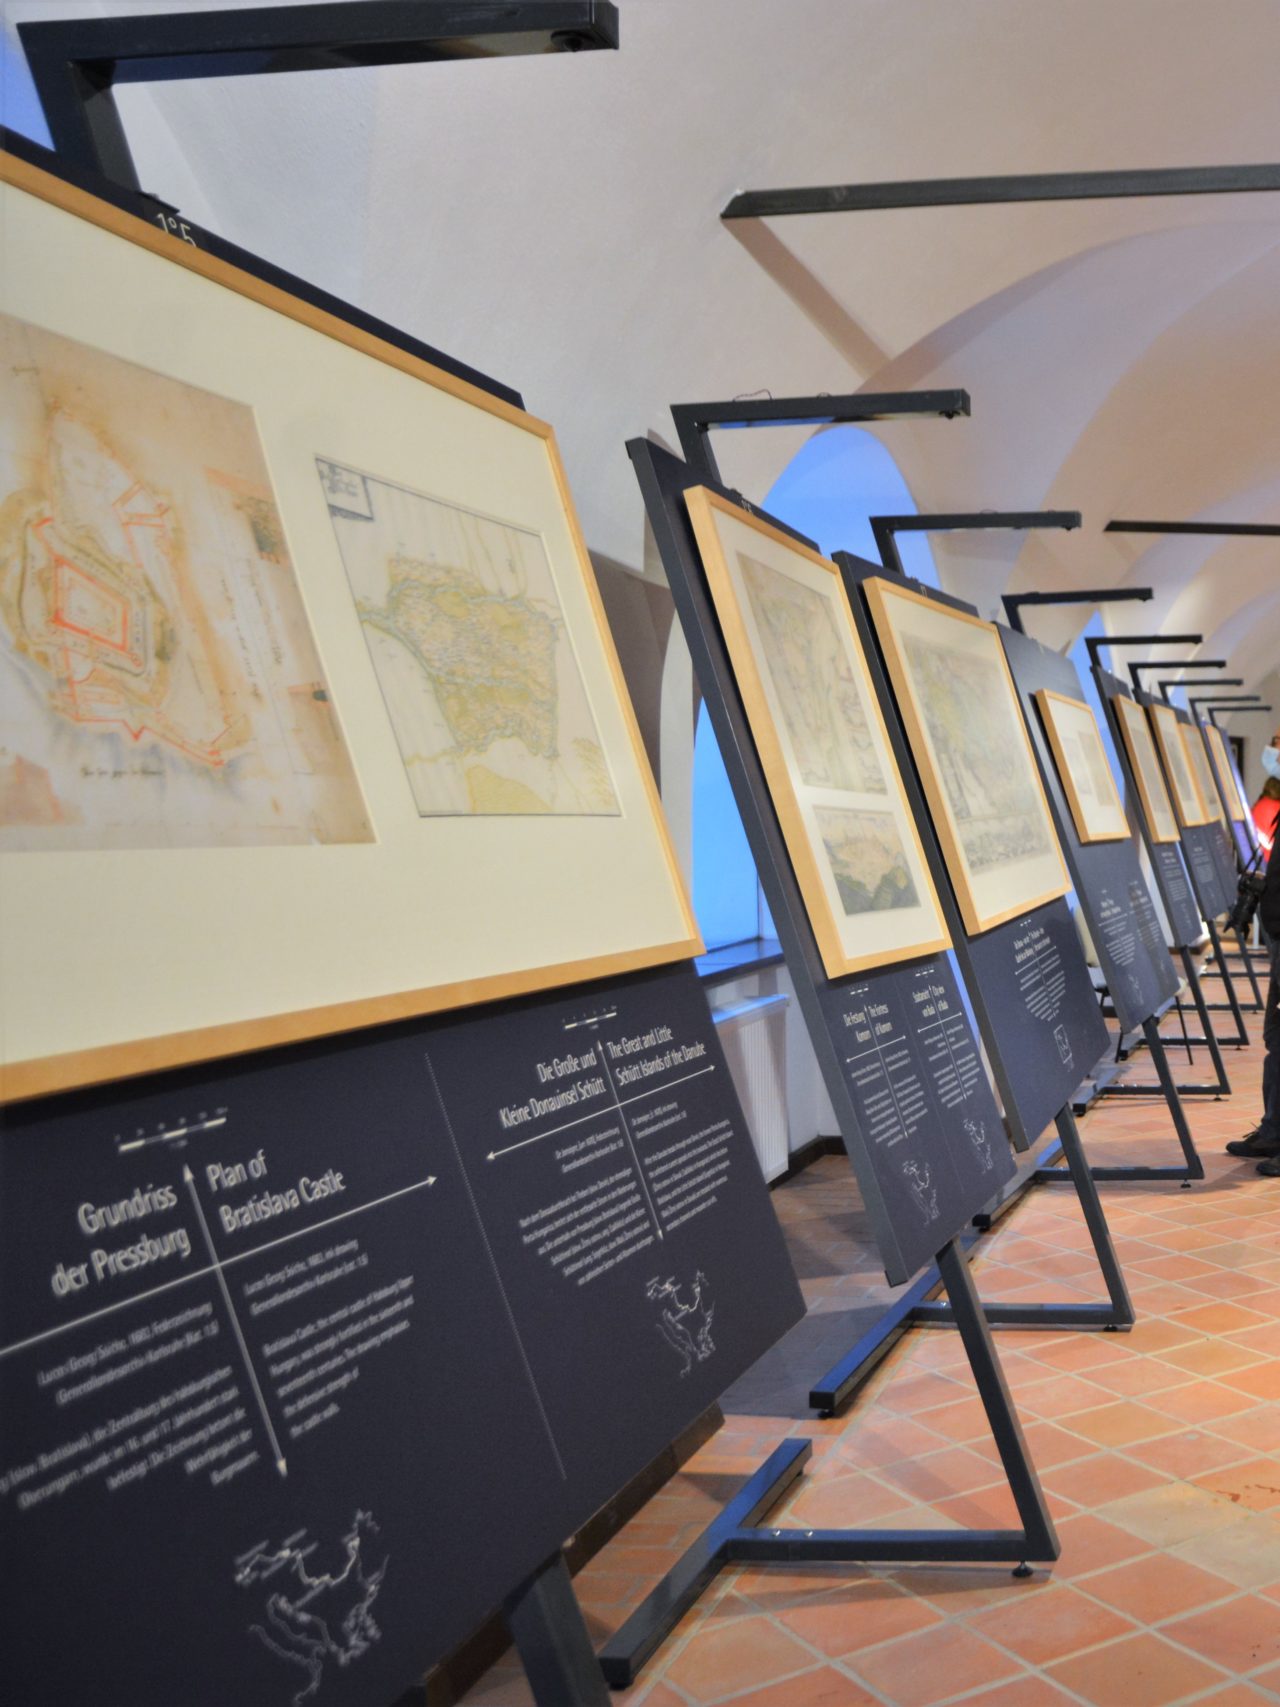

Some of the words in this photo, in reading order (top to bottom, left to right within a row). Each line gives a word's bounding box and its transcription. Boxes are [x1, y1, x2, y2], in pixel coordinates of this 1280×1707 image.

[537, 1063, 555, 1083] Die
[552, 1055, 580, 1077] Große
[580, 1048, 598, 1069] und
[607, 1041, 624, 1059] The
[621, 1036, 643, 1056] Great
[642, 1028, 656, 1048] and
[654, 1024, 674, 1044] Little
[615, 1063, 642, 1087] Schütt
[640, 1055, 665, 1076] Islands
[664, 1051, 673, 1068] of
[671, 1048, 684, 1064] the
[681, 1041, 707, 1062] Danube
[499, 1104, 532, 1129] Kleine
[529, 1088, 580, 1118] Donauinsel
[578, 1076, 607, 1101] Schütt
[206, 1163, 248, 1192] Plan
[249, 1149, 268, 1179] of
[77, 1184, 178, 1236] Grundriss
[219, 1189, 300, 1234] Bratislava
[299, 1168, 347, 1202] Castle
[51, 1262, 89, 1298] der
[90, 1227, 192, 1282] Pressburg
